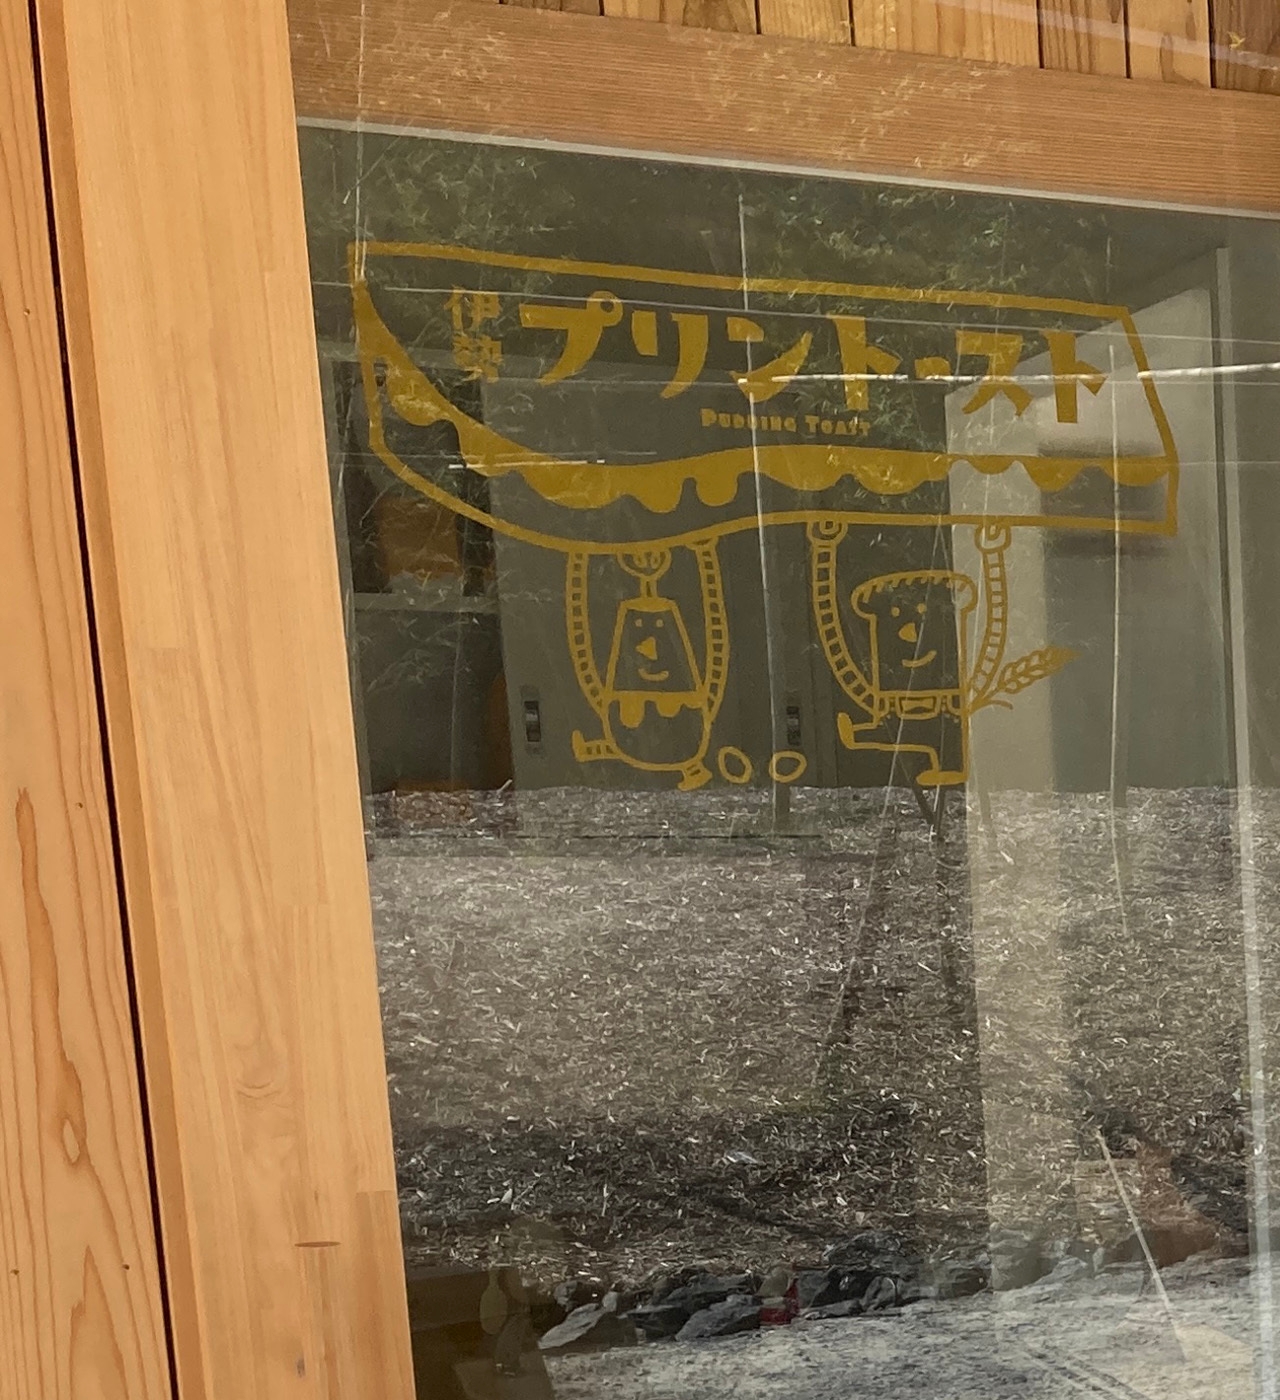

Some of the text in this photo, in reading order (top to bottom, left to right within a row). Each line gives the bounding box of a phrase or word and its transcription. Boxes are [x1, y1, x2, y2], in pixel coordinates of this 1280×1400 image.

[519, 290, 1112, 425] プリントースト
